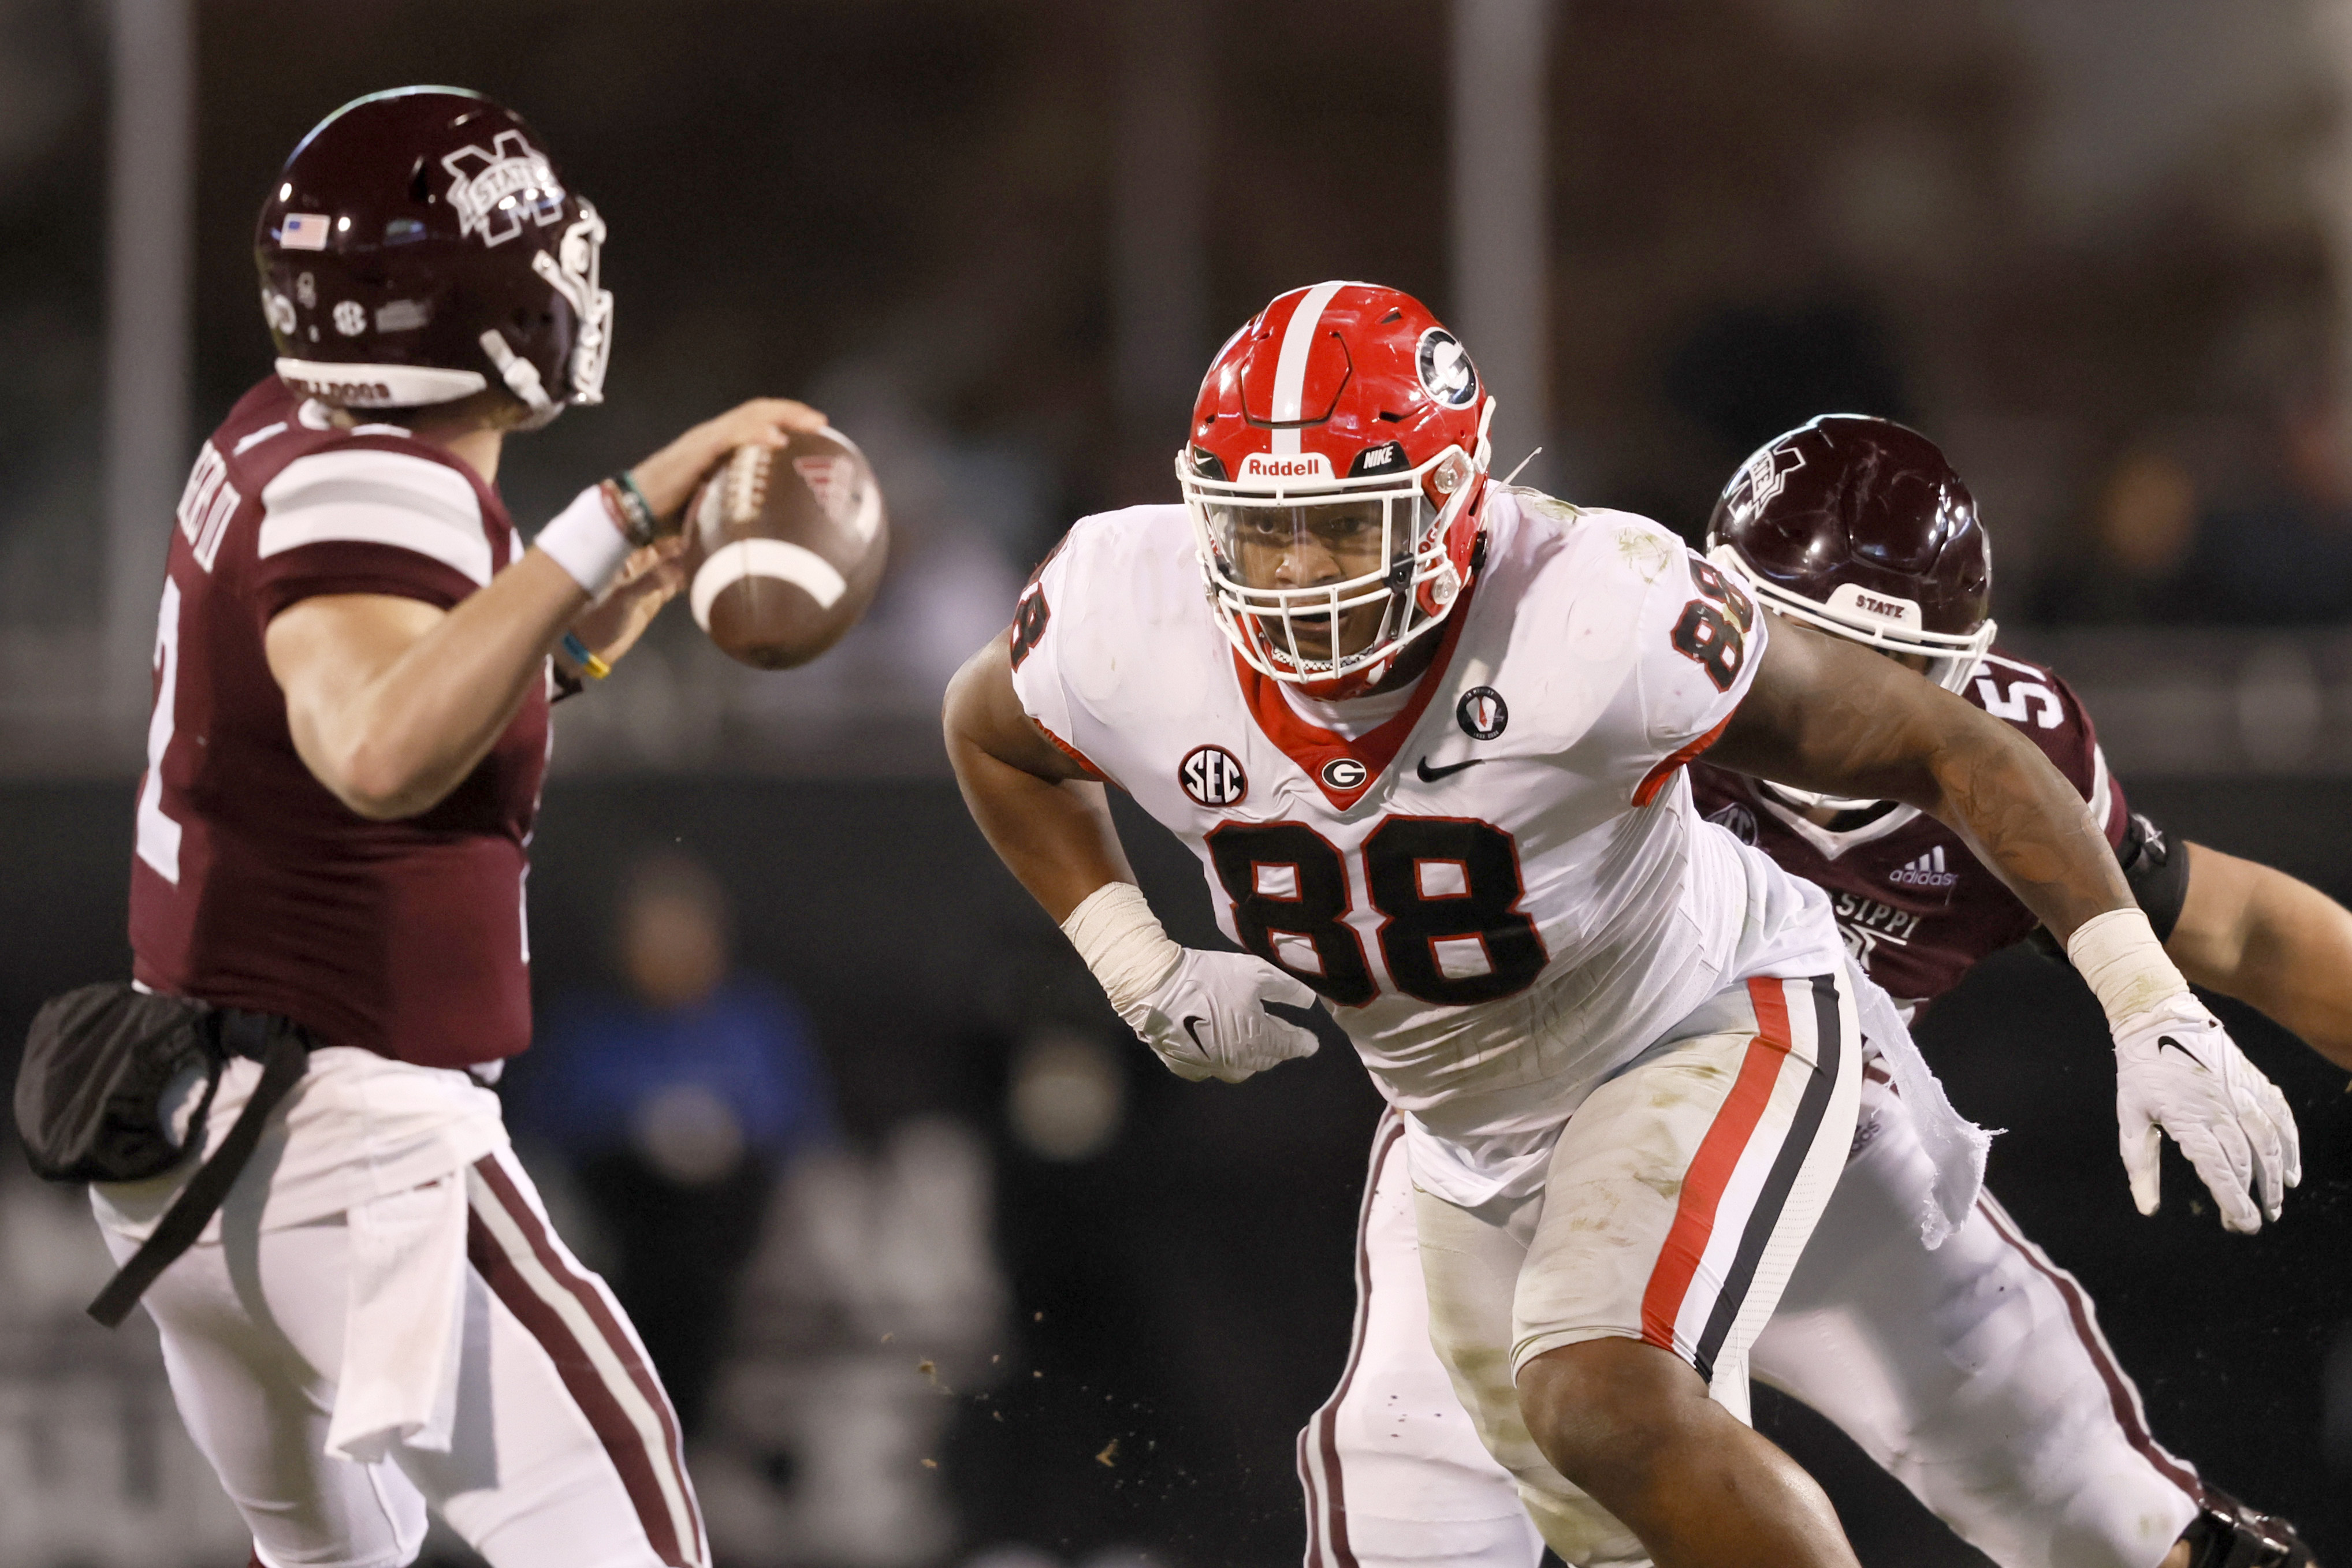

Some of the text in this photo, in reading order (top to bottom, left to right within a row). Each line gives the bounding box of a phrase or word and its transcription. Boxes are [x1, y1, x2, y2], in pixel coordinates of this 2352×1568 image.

[1249, 459, 1319, 476] Riddell
[1363, 446, 1394, 469] NIKE
[1856, 594, 1904, 619] STATE
[1670, 556, 1754, 694] 88
[1184, 749, 1242, 803] SEC
[1889, 869, 1952, 887] adidas
[1203, 814, 1551, 1009] 88
